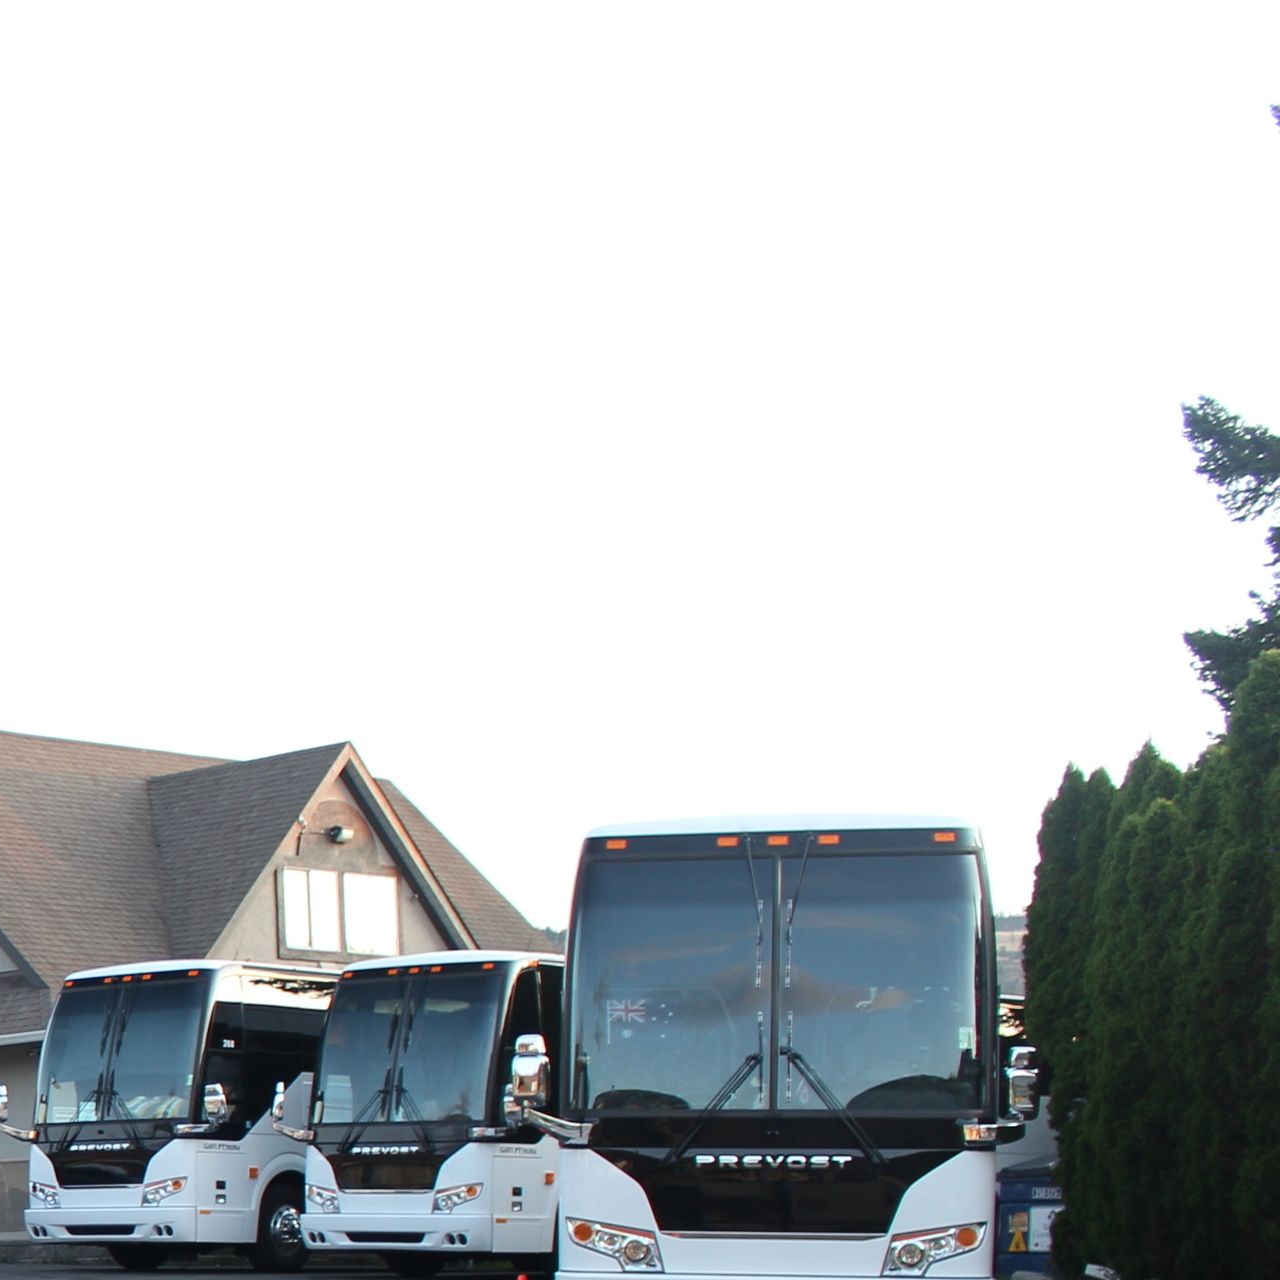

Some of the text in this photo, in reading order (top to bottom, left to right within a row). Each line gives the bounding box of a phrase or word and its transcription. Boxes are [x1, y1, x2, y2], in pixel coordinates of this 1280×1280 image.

[69, 1142, 130, 1152] PREVOST
[351, 1145, 420, 1155] PREVOST
[695, 1154, 853, 1169] PREVOST
